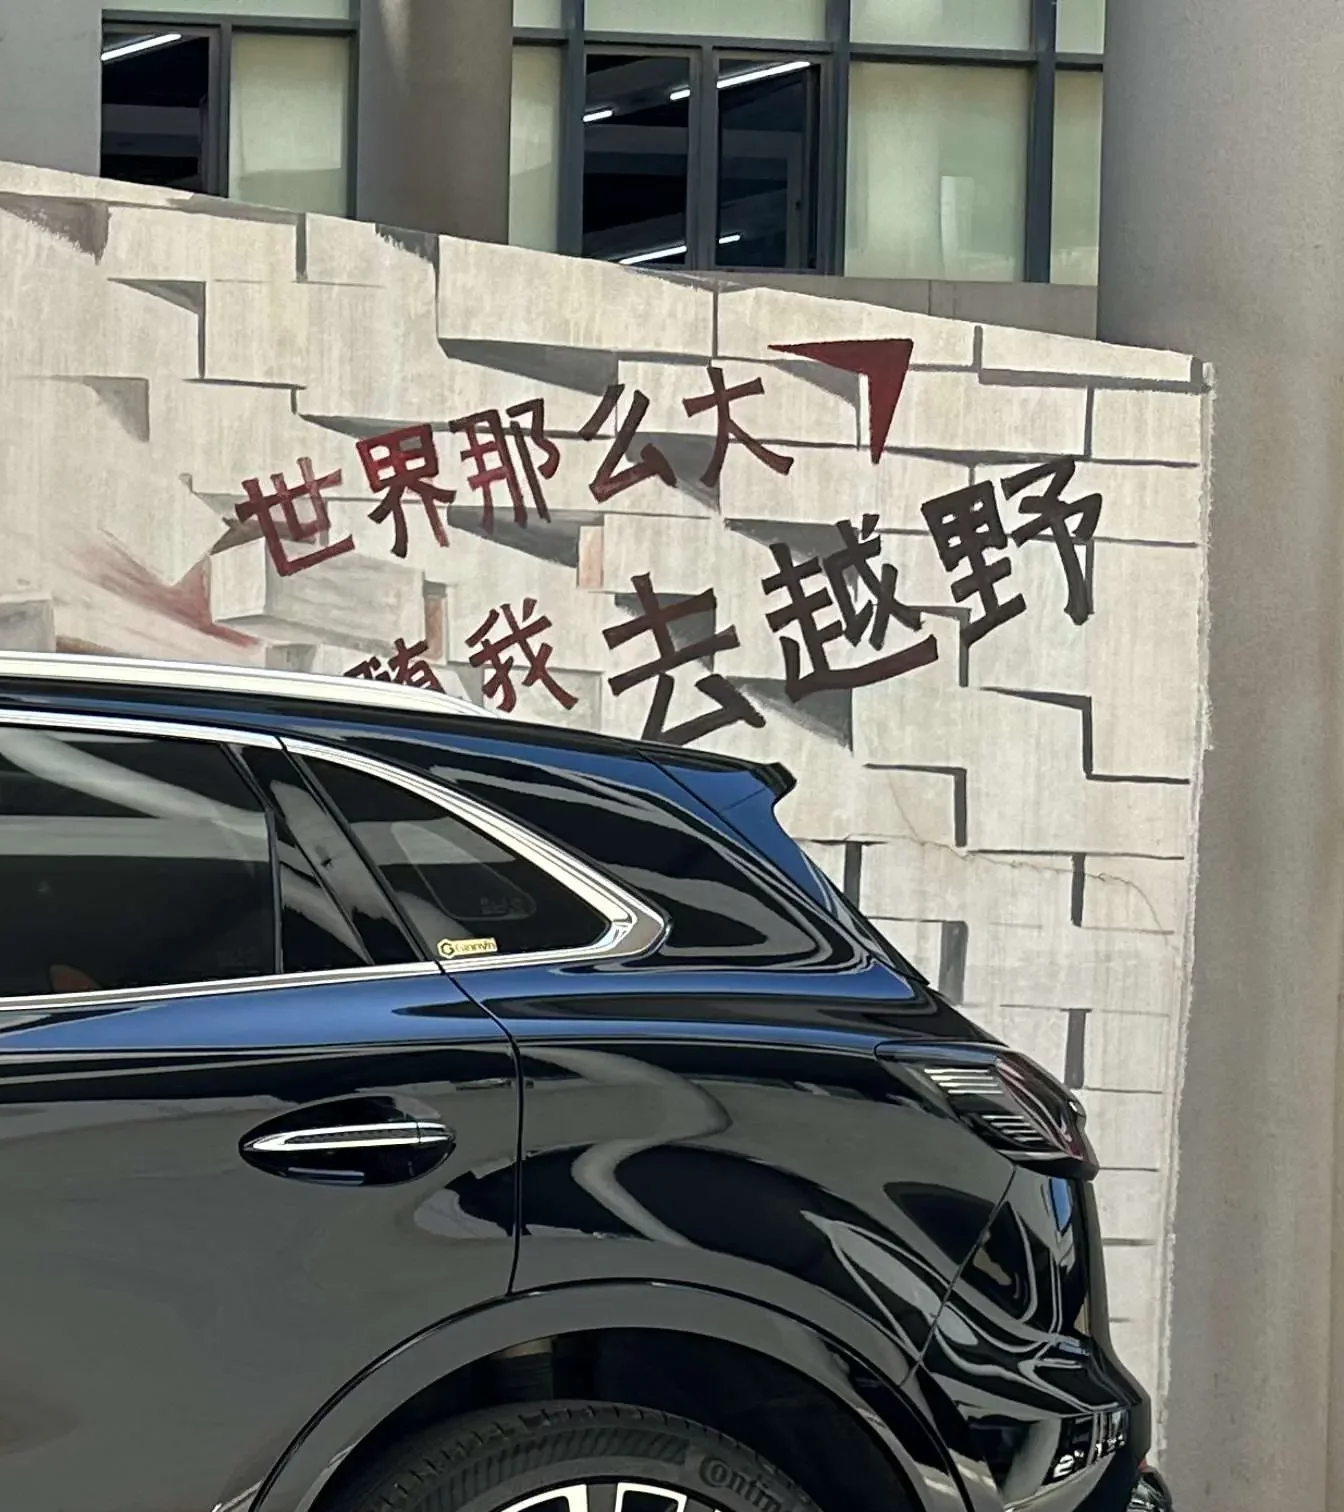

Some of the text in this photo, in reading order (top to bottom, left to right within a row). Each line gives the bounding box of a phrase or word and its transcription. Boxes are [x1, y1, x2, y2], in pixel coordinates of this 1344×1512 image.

[235, 366, 794, 577] 世界那么大
